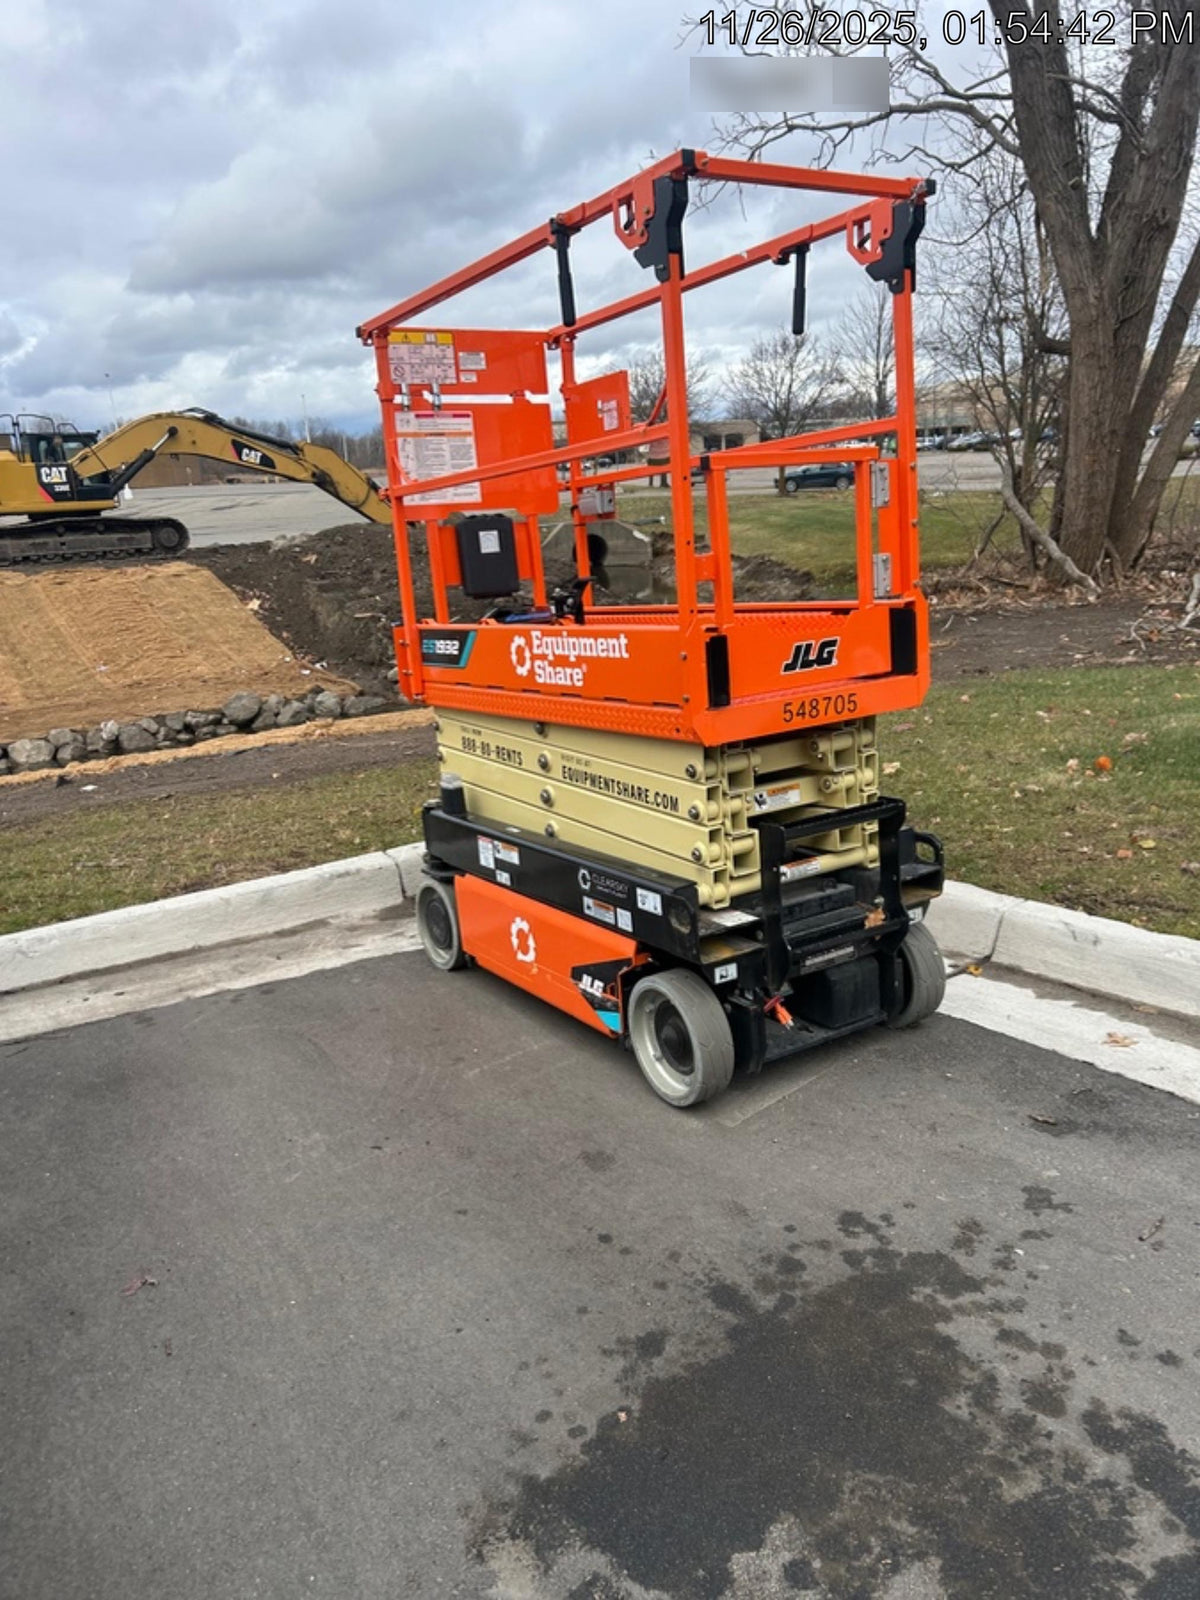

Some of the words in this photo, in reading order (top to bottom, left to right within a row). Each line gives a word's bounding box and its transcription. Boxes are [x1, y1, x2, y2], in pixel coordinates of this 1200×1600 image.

[241, 448, 262, 464] CAT
[40, 466, 67, 483] CAT
[531, 630, 630, 662] Equipment
[781, 637, 840, 675] JLG
[783, 693, 857, 723] 548705
[561, 765, 679, 813] EQUIPMENTSHARE.COM
[579, 973, 605, 998] JLG
